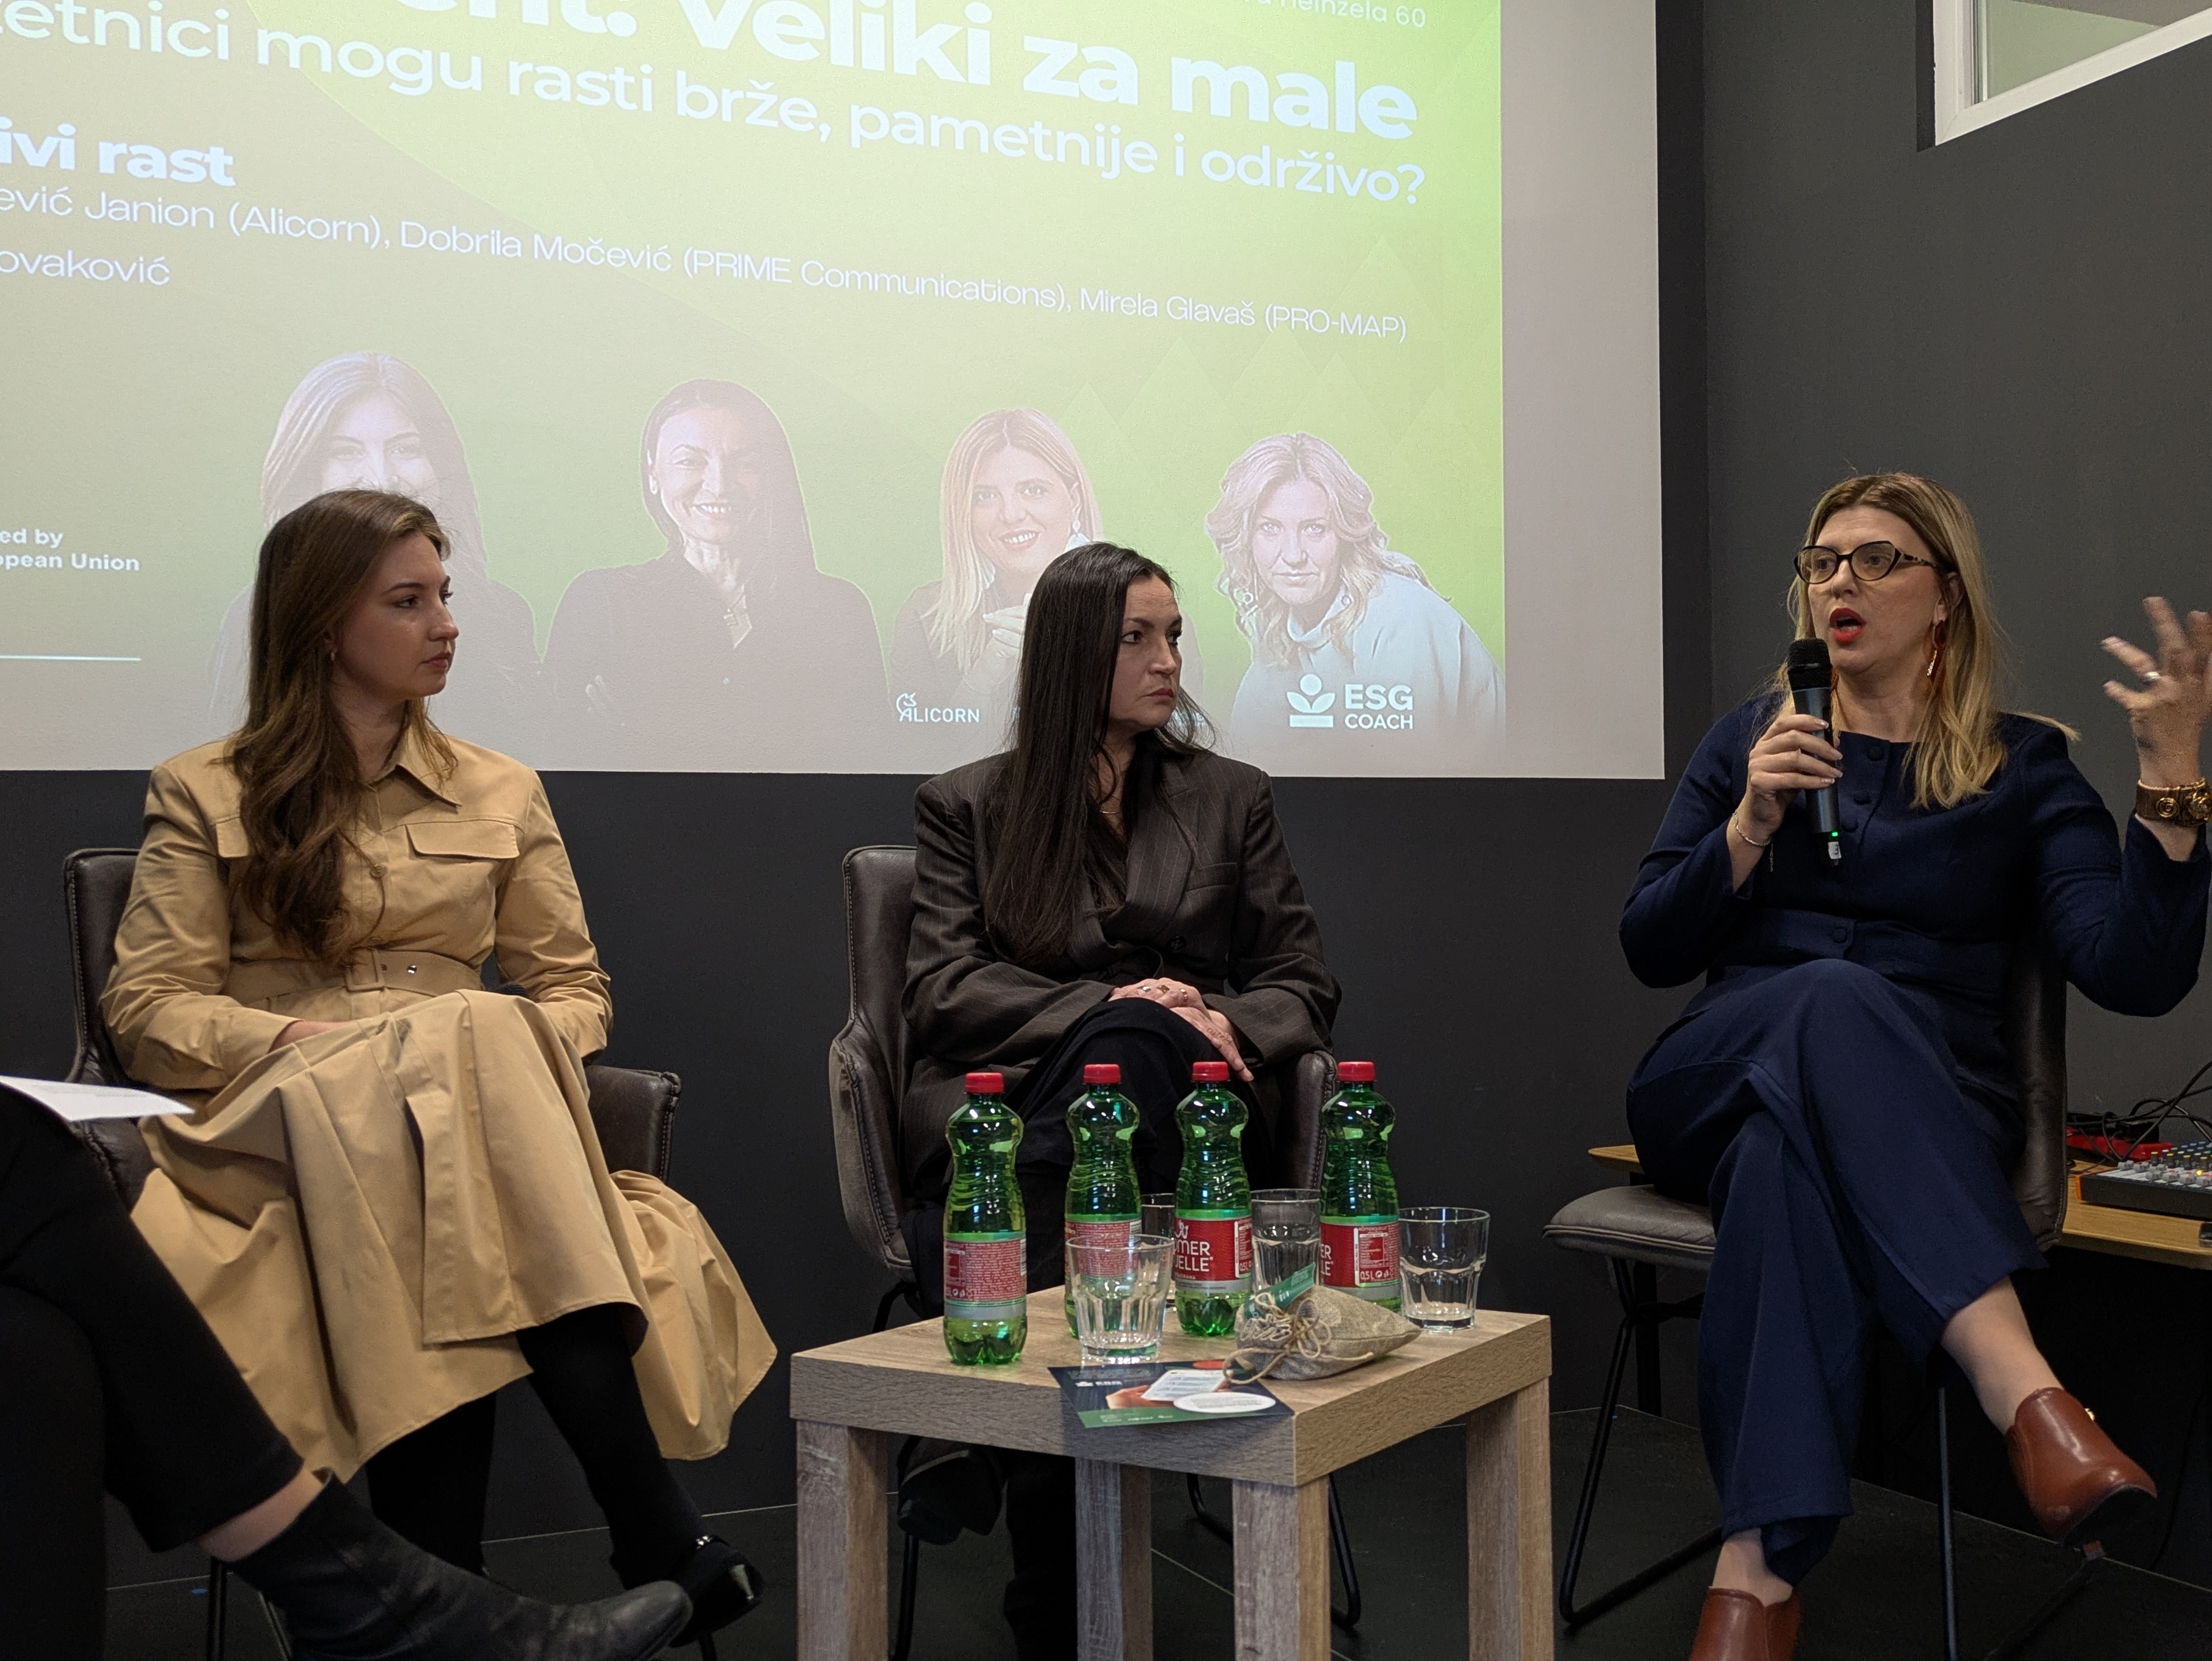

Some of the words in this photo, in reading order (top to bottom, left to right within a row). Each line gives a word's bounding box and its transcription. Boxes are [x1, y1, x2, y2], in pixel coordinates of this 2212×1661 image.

[1396, 6, 1426, 28] 60
[681, 0, 992, 86] veliki
[1023, 34, 1139, 105] za
[1171, 56, 1417, 139] male
[0, 0, 230, 61] etnici
[257, 28, 482, 96] mogu
[508, 63, 653, 112] rasti
[676, 70, 831, 143] brže,
[850, 104, 1158, 179] pametnije
[1173, 133, 1185, 177] i
[1201, 145, 1426, 204] održivo?
[99, 141, 236, 186] rast
[84, 191, 214, 229] Janion
[229, 201, 390, 249] (Alicorn),
[401, 221, 521, 258] Dobrila
[533, 234, 672, 271] Močević
[684, 246, 792, 283] (PRIME
[801, 260, 1072, 312] Communications),
[1079, 288, 1158, 317] Mirela
[1166, 295, 1255, 326] Glavaš
[1265, 303, 1407, 343] (PRO-MAP)
[0, 528, 26, 543] ed
[34, 528, 64, 548] by
[0, 554, 63, 569] pean
[71, 553, 140, 571] Union
[1345, 684, 1413, 710] ESG
[898, 708, 980, 722] ALICORN
[1345, 714, 1413, 729] COACH
[1175, 1239, 1210, 1256] MER
